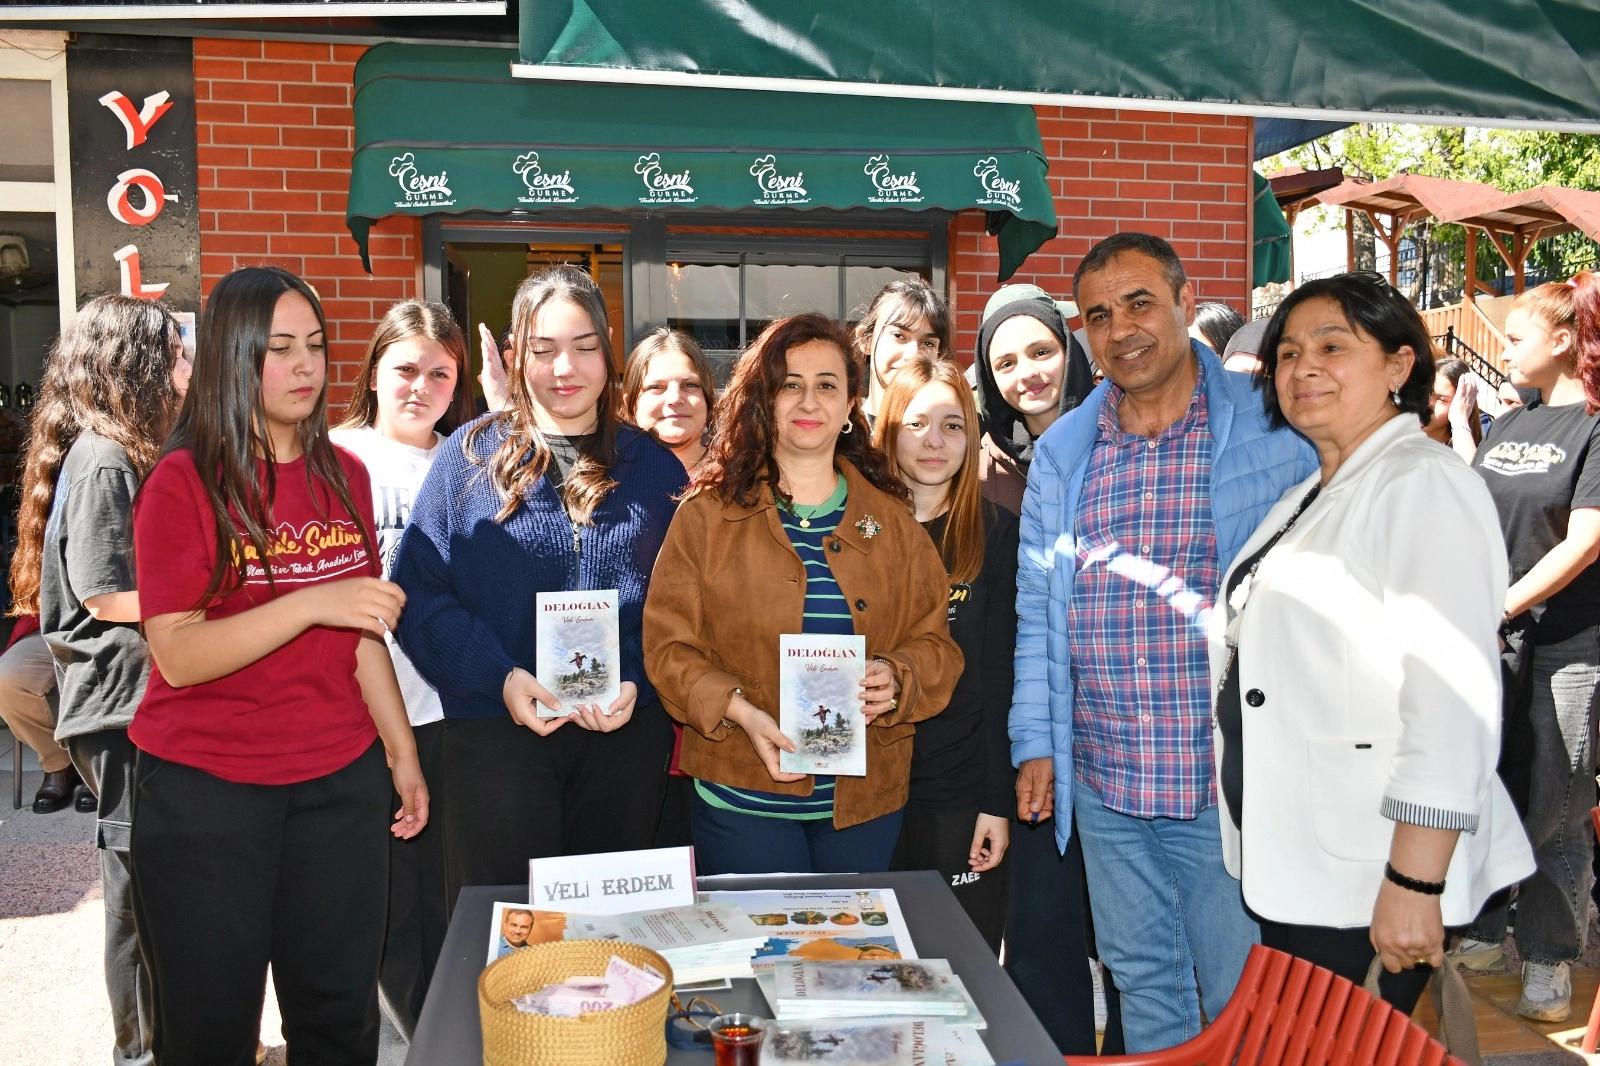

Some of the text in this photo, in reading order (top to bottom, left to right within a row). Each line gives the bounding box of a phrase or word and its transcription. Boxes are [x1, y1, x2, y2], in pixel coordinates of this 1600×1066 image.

[405, 193, 443, 201] GURME
[544, 600, 610, 612] DELOĞLAN
[788, 648, 857, 658] DELOĞLAN
[543, 873, 674, 902] VELİ ERDEM
[611, 961, 629, 975] 200
[792, 963, 807, 997] DELOĞLAN
